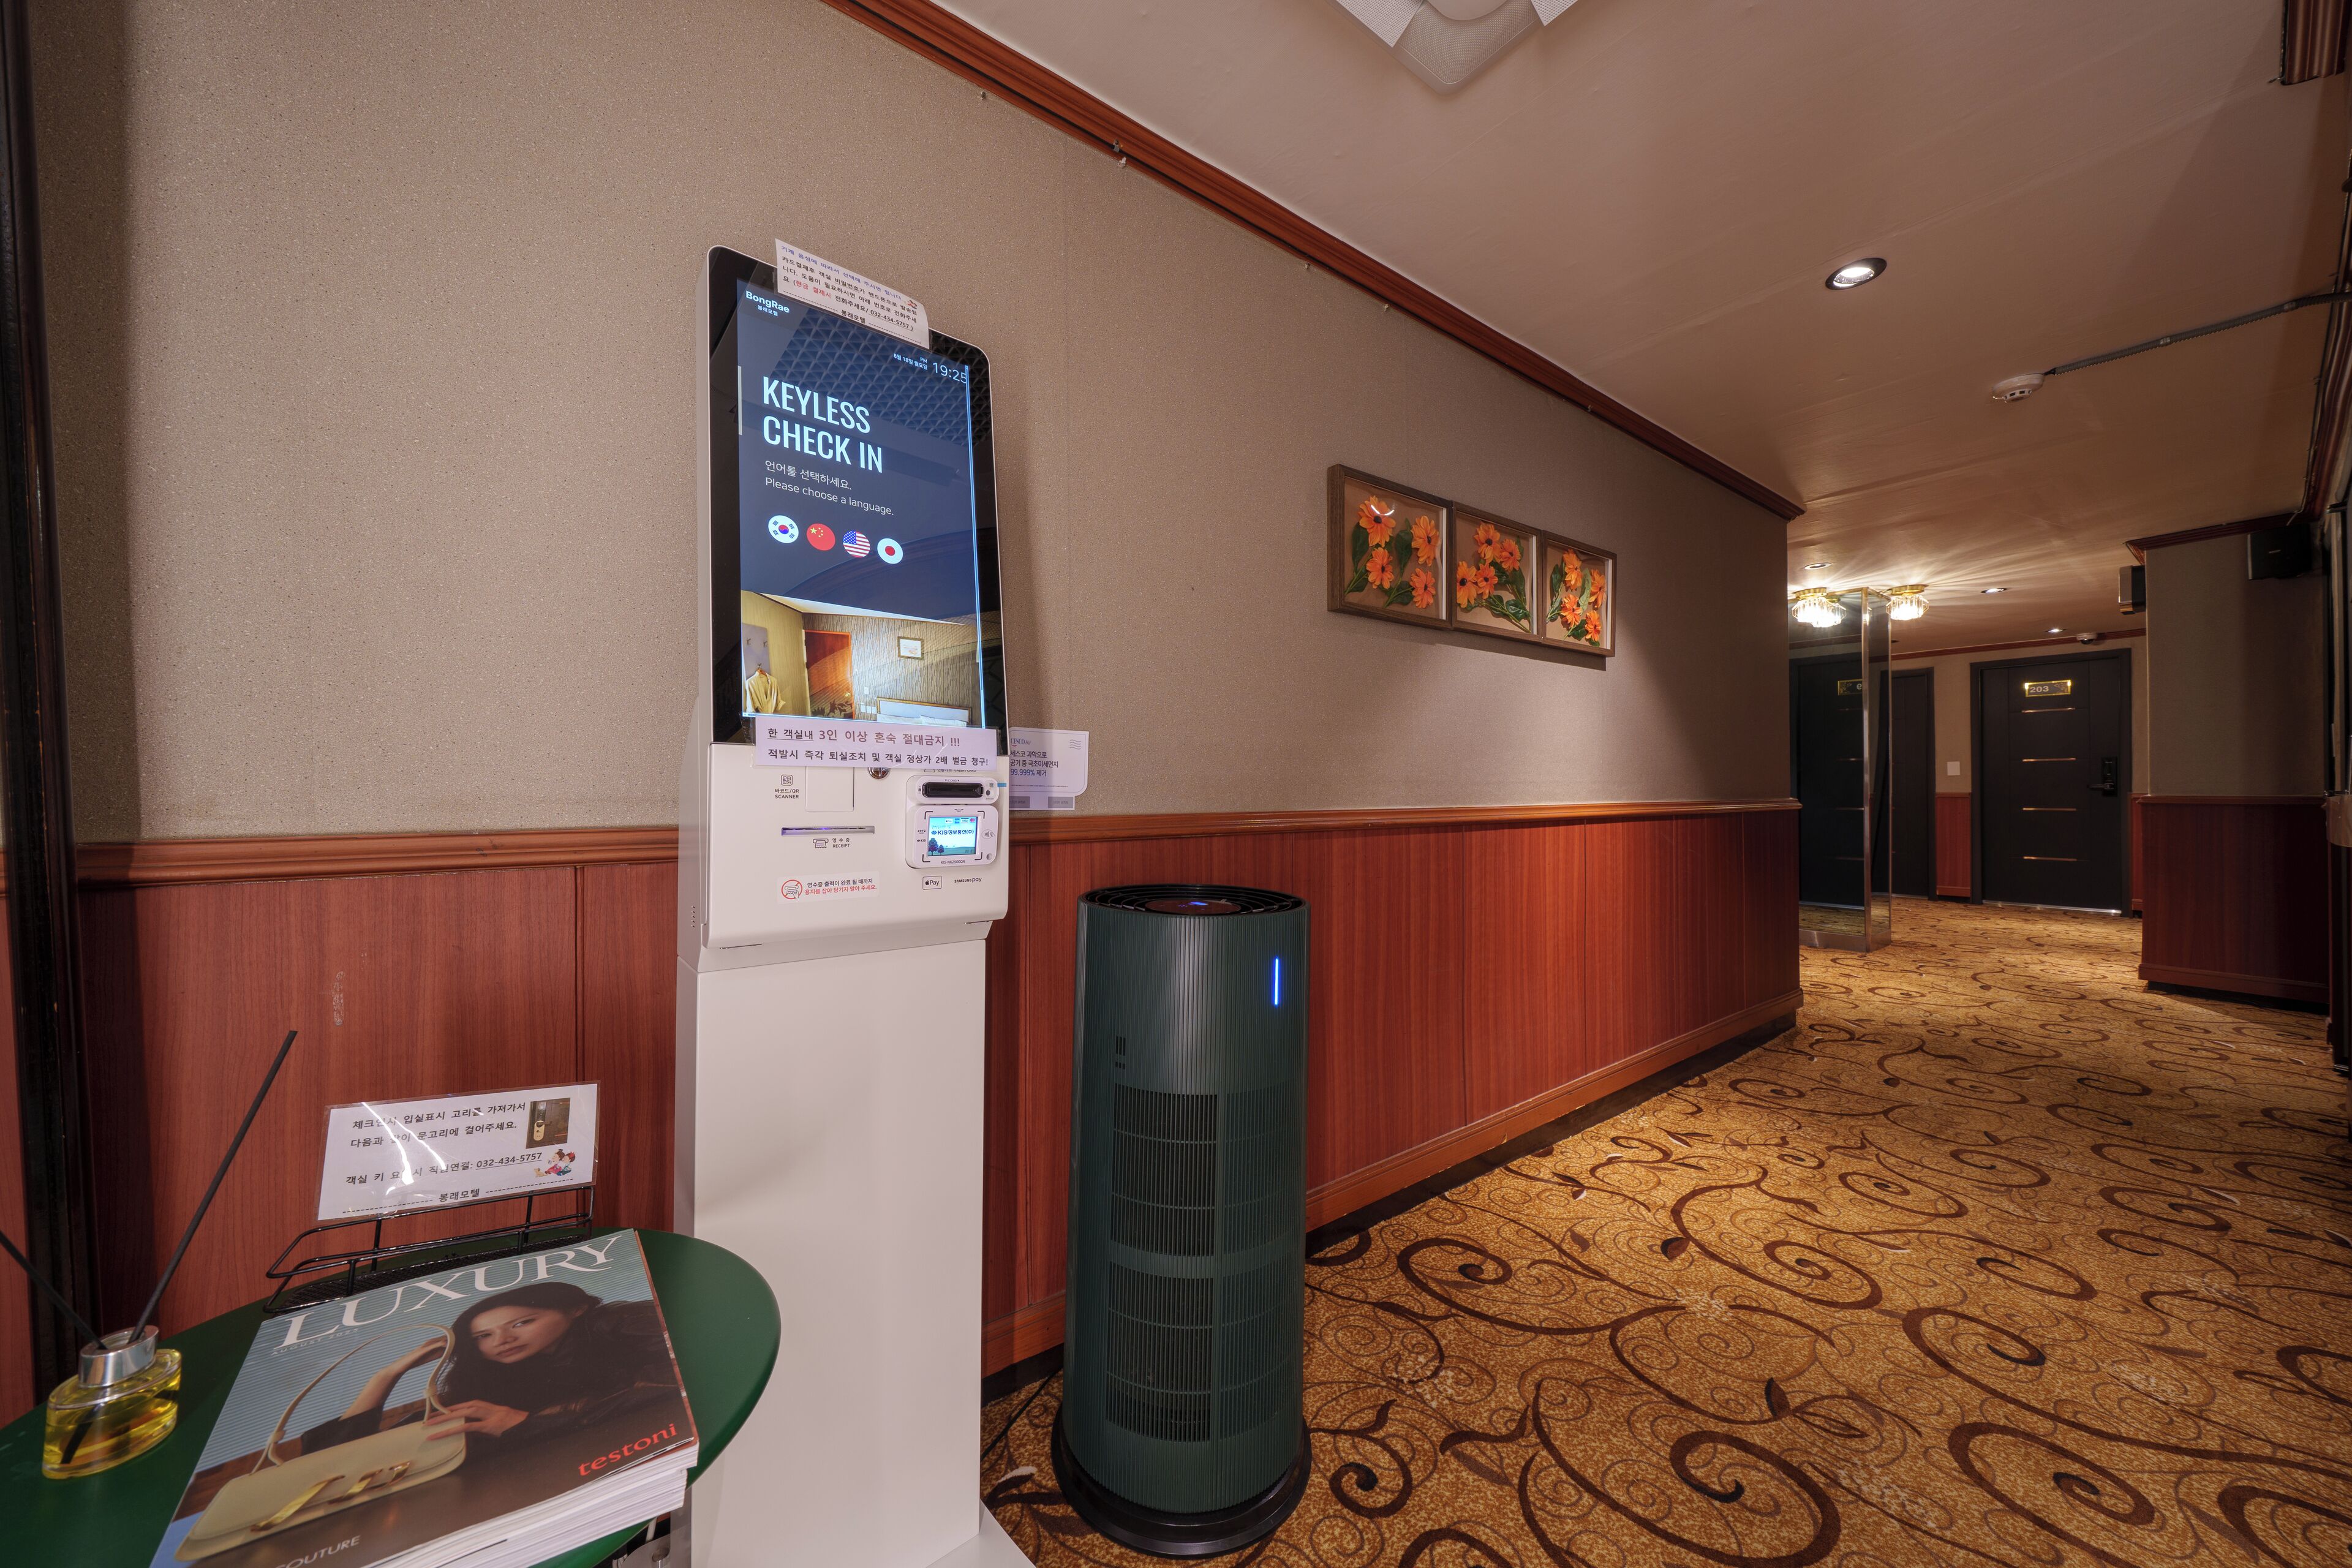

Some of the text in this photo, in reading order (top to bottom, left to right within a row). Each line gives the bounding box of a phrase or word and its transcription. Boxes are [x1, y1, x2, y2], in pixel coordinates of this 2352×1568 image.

[782, 246, 794, 255] 기계
[798, 253, 818, 265] 음성에
[821, 263, 840, 274] 따라서
[843, 272, 861, 283] 선택해
[864, 282, 881, 292] 주시면
[782, 256, 917, 315] 카드결제후 객실 비밀번호가 핸드폰으로 발송됩
[783, 265, 917, 323] 니다. 도움이 필요하시면 아래 번호로 전화주세
[746, 290, 790, 313] BongRae
[793, 279, 809, 290] (현금
[813, 286, 831, 299] 결제시
[870, 309, 909, 329] 032-434-5757
[841, 309, 865, 324] 봉래모텔
[903, 356, 913, 365] 18일
[914, 361, 928, 371] 월요일
[933, 363, 967, 383] 19:25
[763, 376, 870, 434] KEYLESS
[763, 415, 883, 473] CHECK IN
[765, 460, 852, 490] 언어를 선택하세요.
[766, 477, 799, 493] Please
[802, 487, 838, 502] choose
[849, 497, 894, 516] language.
[767, 728, 778, 738] 한
[783, 729, 813, 740] 객실내
[819, 729, 838, 741] 3인
[845, 730, 868, 742] 이상
[875, 732, 897, 744] 혼숙
[903, 733, 944, 747] 절대금지
[768, 749, 988, 766] 적발시 즉각 퇴실조치 및 객실 정상가 2배 벌금 청구!
[404, 1111, 445, 1124] 입실표시
[451, 1107, 482, 1118] 고리를
[487, 1102, 526, 1114] 가져가서
[350, 1136, 384, 1147] 다음과
[417, 1128, 459, 1140] 문고리에
[465, 1121, 517, 1135] 걸어주세요.
[346, 1174, 368, 1185] 객실
[374, 1172, 384, 1182] 키
[390, 1167, 423, 1180] 요시
[476, 1152, 543, 1168] 032-434-5757
[439, 1188, 480, 1202] 봉래모텔
[274, 1235, 622, 1349] LUXURY
[271, 1338, 324, 1356] AUGUST
[578, 1423, 677, 1476] testoni
[275, 1535, 361, 1568] OUTURE
